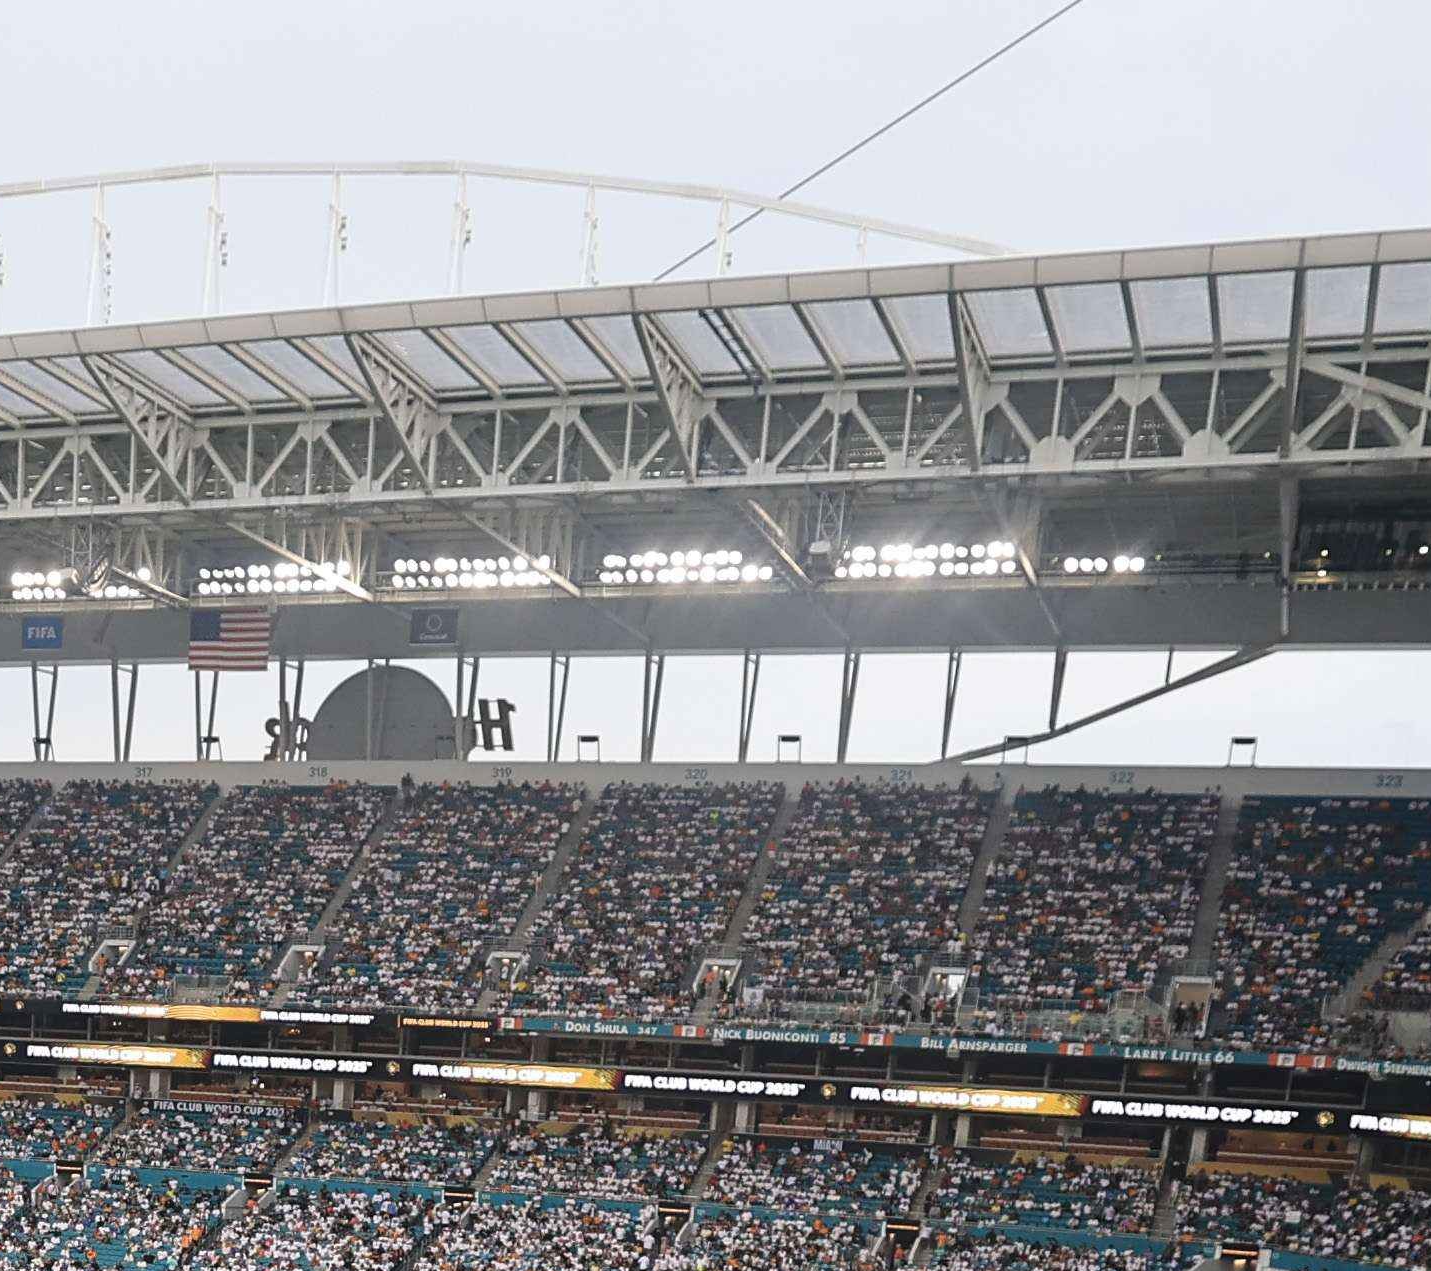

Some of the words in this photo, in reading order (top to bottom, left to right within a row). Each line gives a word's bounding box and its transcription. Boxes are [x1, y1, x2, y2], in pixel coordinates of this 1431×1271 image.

[27, 626, 56, 640] FIFA
[308, 766, 328, 777] 318
[565, 1021, 591, 1033] DON
[594, 1022, 628, 1034] SHULA
[638, 1026, 657, 1035] 347
[712, 1028, 741, 1039] NICK
[745, 1029, 820, 1043] BUONICONTI
[829, 1032, 846, 1044] 85
[920, 1037, 944, 1049] BILL
[948, 1038, 1028, 1053] ARNSPARGER
[153, 1100, 174, 1111] FIFA
[177, 1101, 203, 1112] CLUB
[204, 1103, 241, 1114] WORLD
[243, 1105, 264, 1116] CUP
